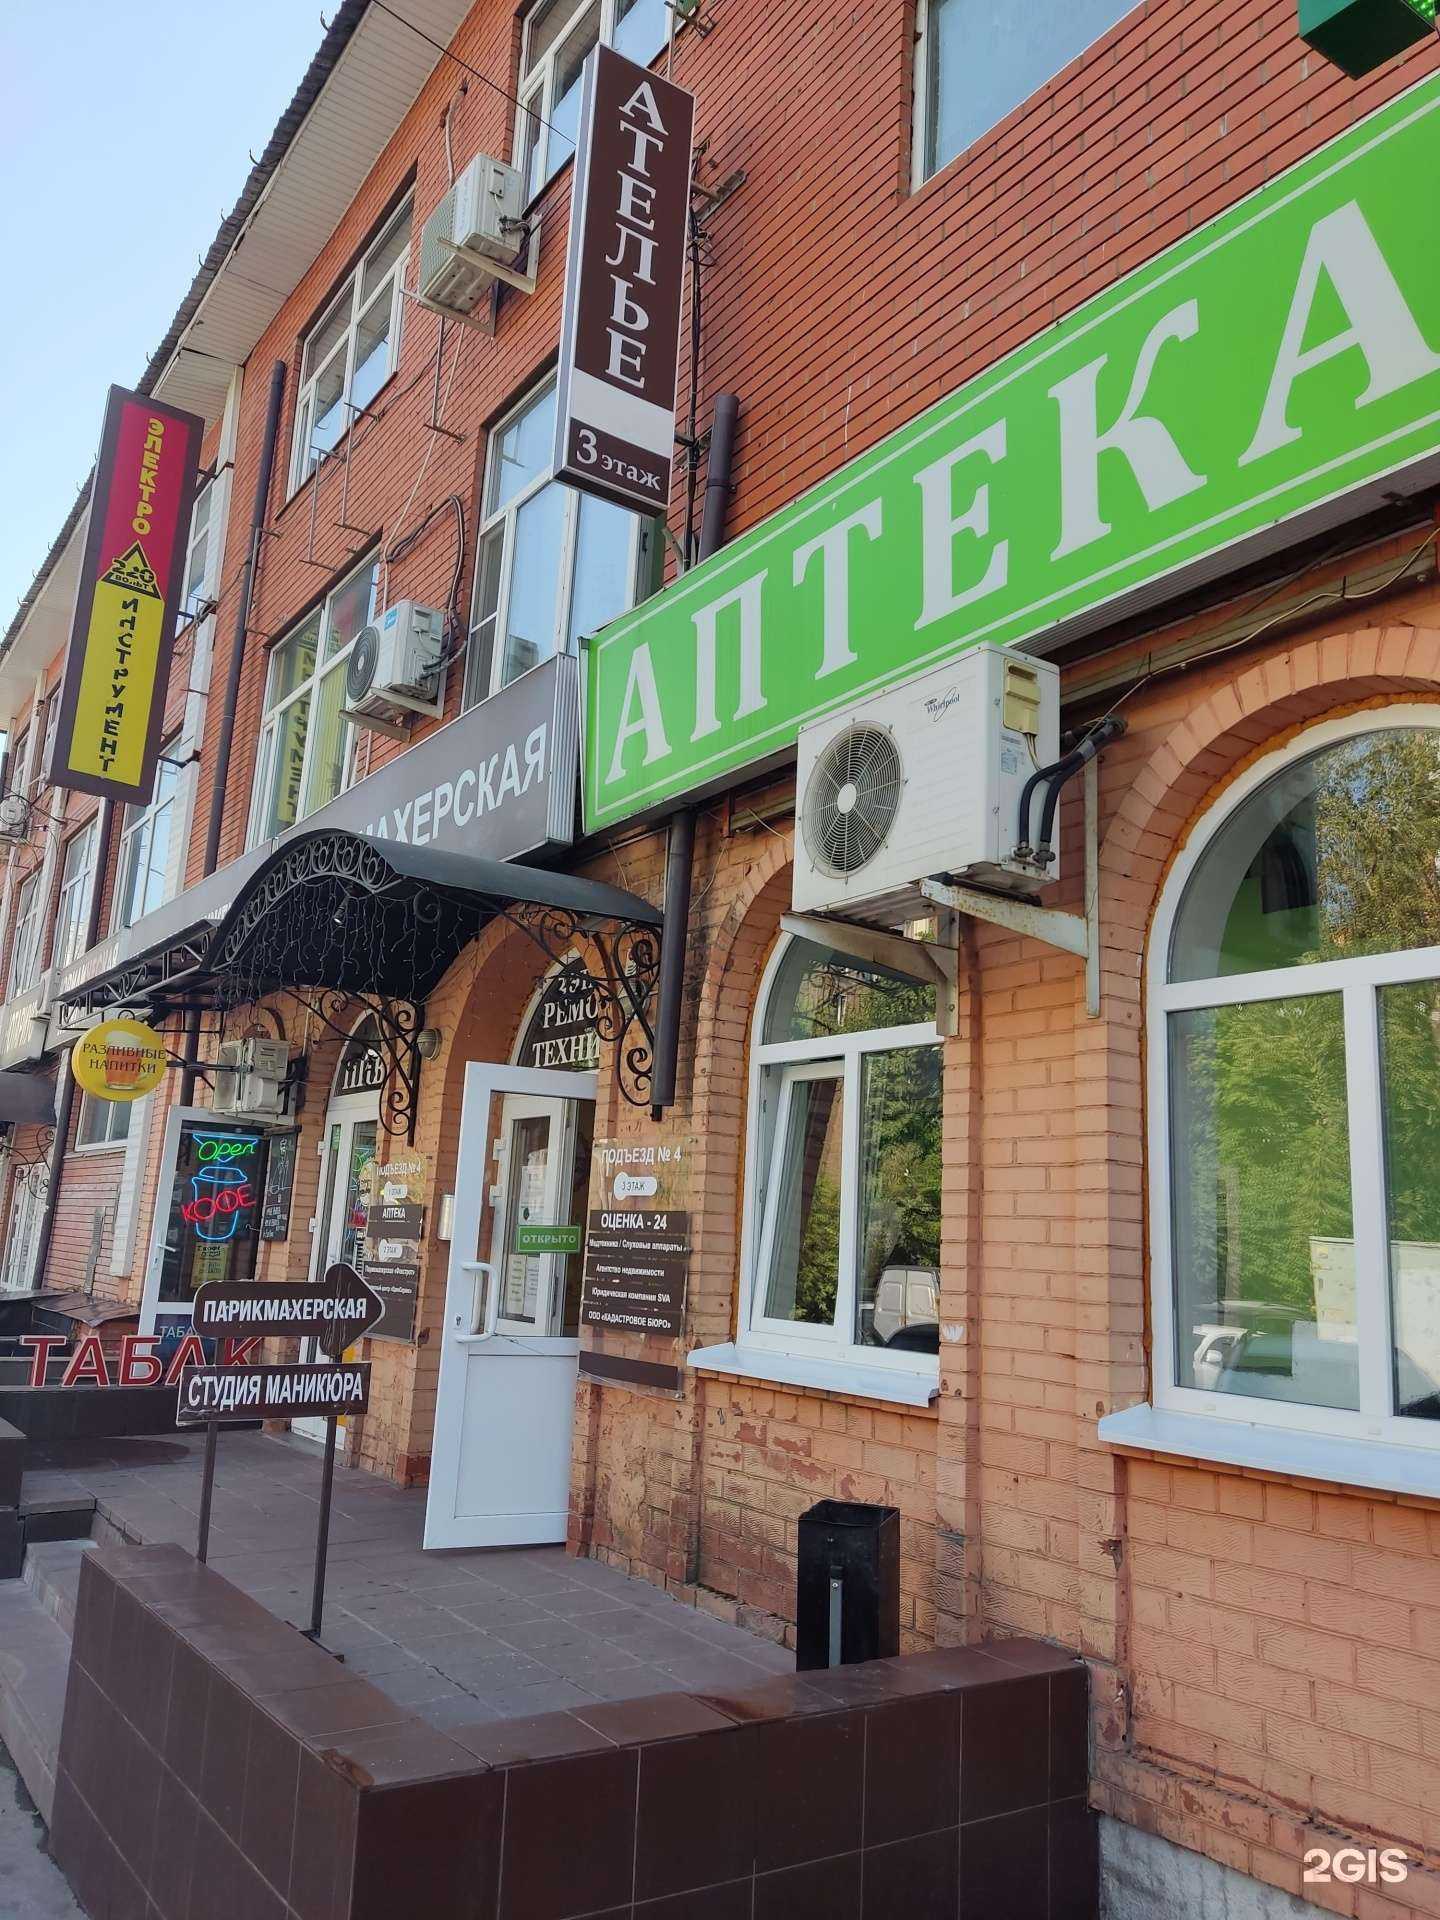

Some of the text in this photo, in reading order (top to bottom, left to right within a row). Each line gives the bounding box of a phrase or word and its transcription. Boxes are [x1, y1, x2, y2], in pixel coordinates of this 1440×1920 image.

[605, 80, 669, 389] АТЕЛЬЕ
[576, 428, 661, 491] 3 этаж
[132, 417, 165, 535] ЭЛЕКТРО
[604, 198, 1440, 785] АПТЕКА
[99, 598, 138, 771] ИНСТРУМЕНТ
[82, 1043, 167, 1060] РАЗЛИВНЫЕ
[89, 1059, 156, 1074] НАПИТКИ
[198, 1141, 255, 1161] Open
[601, 1147, 655, 1166] ПОДЪЕЗД
[673, 1146, 682, 1162] 4
[181, 1184, 257, 1223] КОФЕ
[382, 1207, 406, 1219] АПТЕКА
[601, 1213, 645, 1231] ОЦЕНКА
[653, 1214, 668, 1230] 24
[521, 1234, 577, 1245] ОТКРЫТО
[657, 1293, 671, 1304] SVA
[203, 1297, 368, 1323] ПАРИКМАХЕРСКАЯ
[647, 1317, 672, 1330] БЮРО»
[187, 1372, 364, 1412] СТУДИЯ МАНИКЮРА
